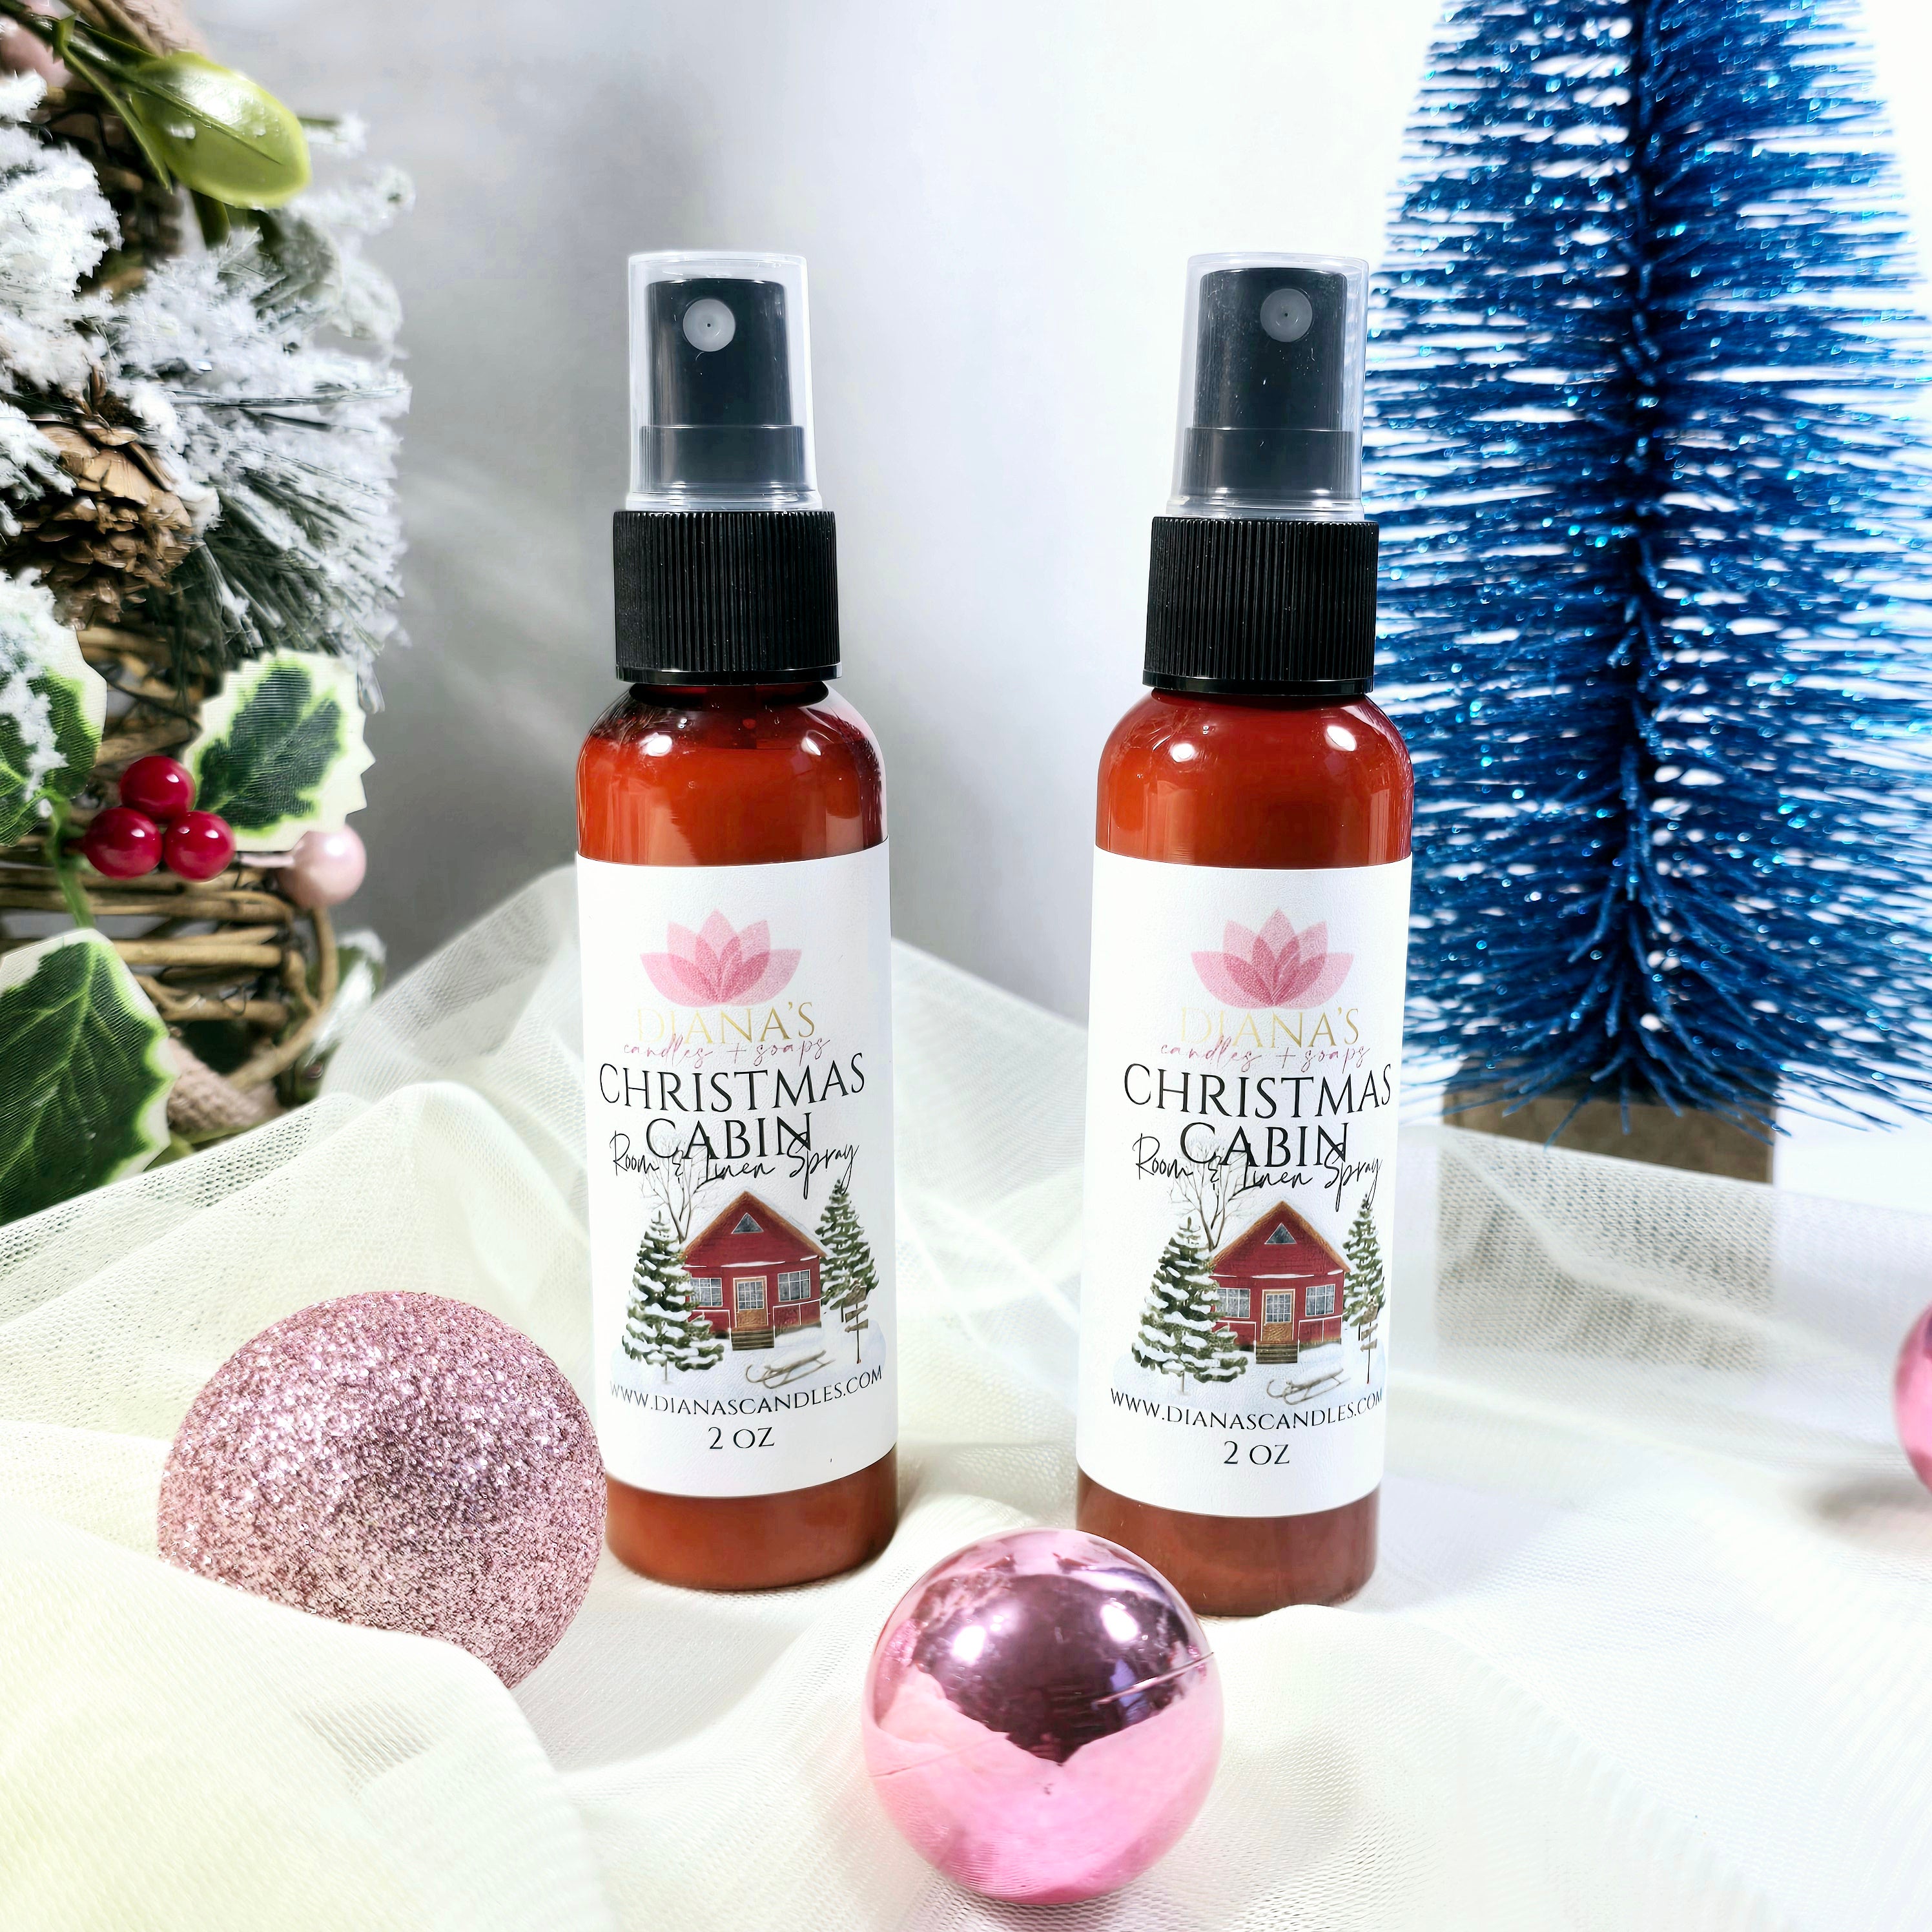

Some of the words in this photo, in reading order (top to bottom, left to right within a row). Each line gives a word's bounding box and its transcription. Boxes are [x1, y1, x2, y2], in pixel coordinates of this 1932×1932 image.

[636, 1002, 816, 1045] DIANA'S
[1181, 1007, 1359, 1049] DIANA'S
[624, 1034, 714, 1069] candles
[754, 1036, 831, 1067] soaps
[1160, 1034, 1262, 1073] candles
[1304, 1045, 1371, 1074] soaps
[600, 1053, 865, 1113] CHRISTMAS
[1124, 1063, 1392, 1119] CHRISTMAS
[646, 1112, 812, 1160] CABIN
[1180, 1122, 1348, 1167] CABIN
[610, 1130, 659, 1177] Room
[701, 1136, 776, 1184] Linen
[786, 1132, 860, 1199] Spray
[1133, 1133, 1193, 1180] Room
[1241, 1142, 1313, 1190] Linen
[1324, 1142, 1383, 1212] Spray
[610, 1364, 883, 1416] WWW.DIANASCANDLES.COM
[1111, 1388, 1383, 1430] WWW.DIANASCANDLES.COM
[708, 1426, 723, 1450] 2
[733, 1426, 775, 1449] OZ
[1224, 1441, 1238, 1465] 2
[1249, 1444, 1290, 1465] OZ
